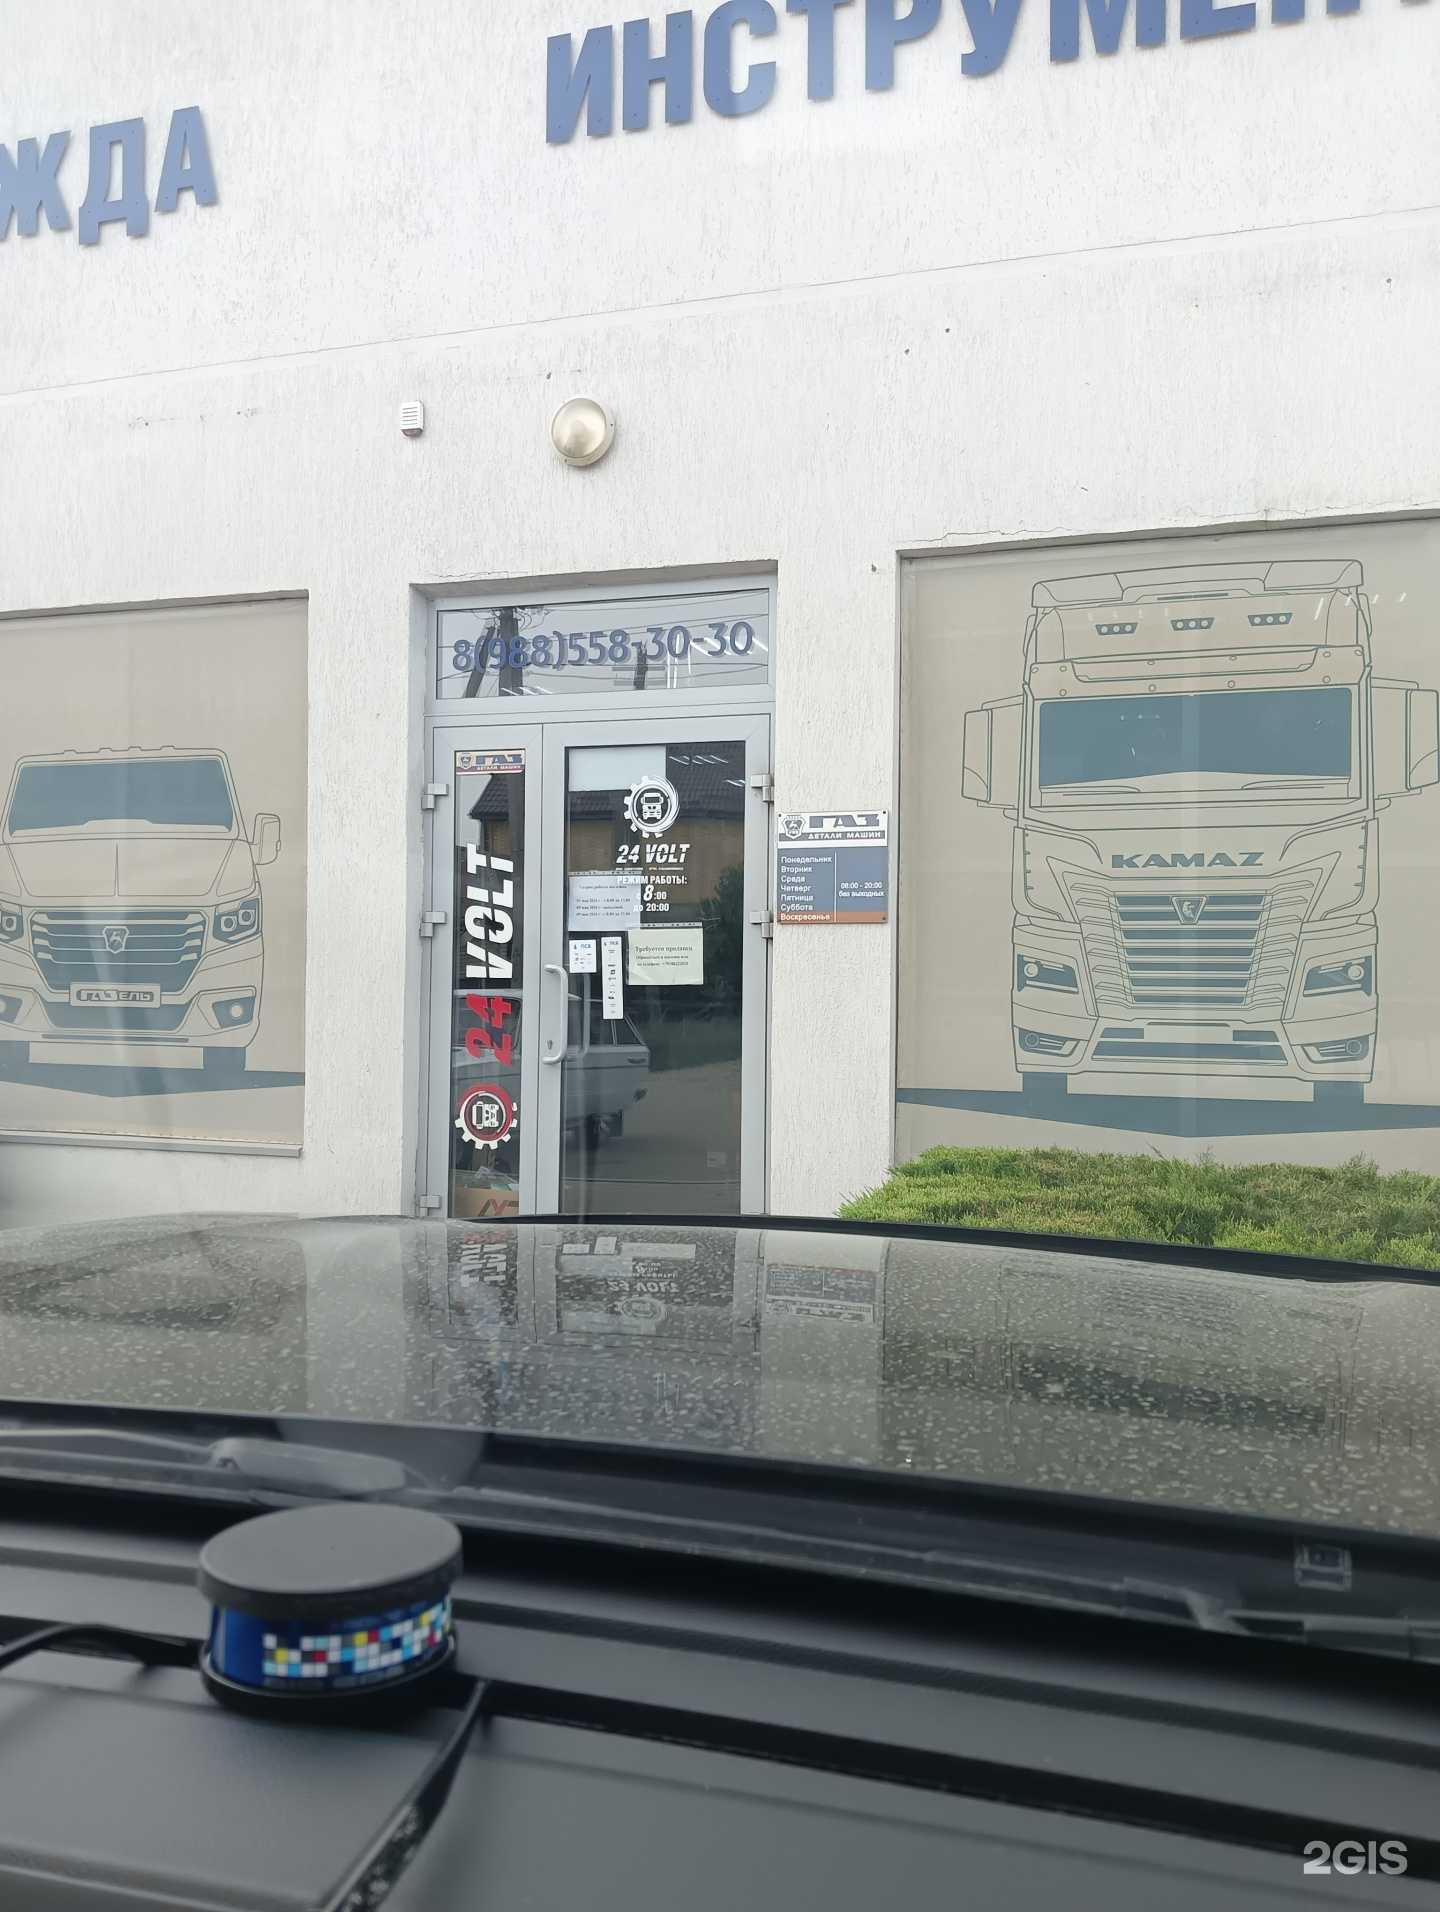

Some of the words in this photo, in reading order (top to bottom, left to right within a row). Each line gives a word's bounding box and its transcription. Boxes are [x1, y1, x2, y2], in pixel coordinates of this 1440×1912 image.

[545, 0, 1432, 144] ИНСТРУМ
[808, 832, 843, 840] ДЕТАЛИ
[846, 831, 881, 839] МАШИН
[616, 844, 640, 864] 24
[645, 843, 691, 864] VOLT
[780, 856, 833, 865] Понедельник
[1111, 851, 1265, 869] KAMAZ
[780, 866, 813, 875] Вторник
[617, 875, 649, 886] РЕЖИМ
[650, 875, 688, 885] РАБОТЫ:
[780, 876, 806, 884] Среда
[780, 885, 812, 894] Четверг
[780, 894, 814, 902] Пятница
[465, 842, 514, 979] VOLT
[645, 903, 670, 912] 20:00
[780, 903, 814, 912] Суббота
[780, 913, 831, 922] Воскресенье
[465, 992, 513, 1067] 24
